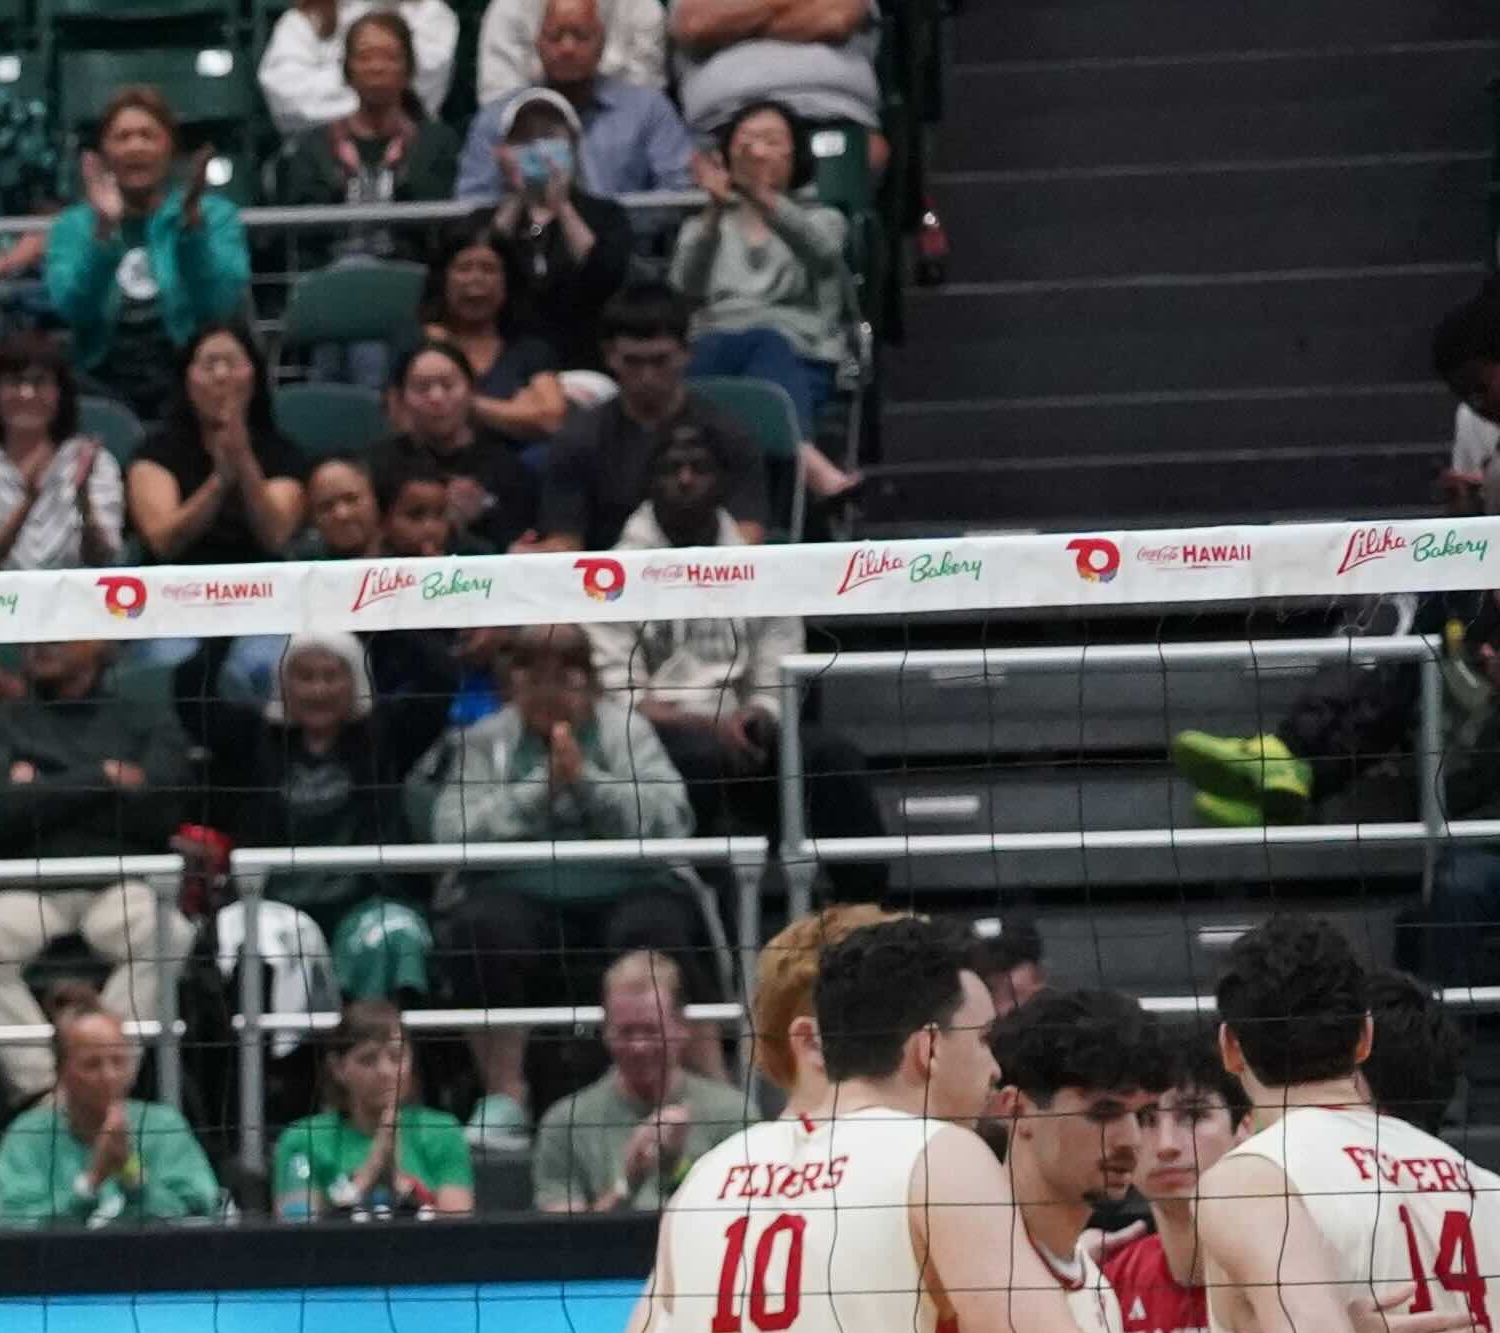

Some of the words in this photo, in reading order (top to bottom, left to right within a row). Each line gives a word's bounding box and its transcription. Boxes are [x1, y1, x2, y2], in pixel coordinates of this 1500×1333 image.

[686, 563, 756, 585] HAWAII
[836, 547, 907, 596] Liliha
[908, 550, 984, 585] Bakery
[1182, 544, 1252, 563] HAWAII
[1335, 525, 1406, 577] Liliha
[1410, 528, 1490, 564] Bakery
[205, 580, 274, 601] HAWAII
[349, 566, 419, 614] Liliha
[420, 568, 493, 601] Bakery
[716, 1154, 850, 1200] FLYERS
